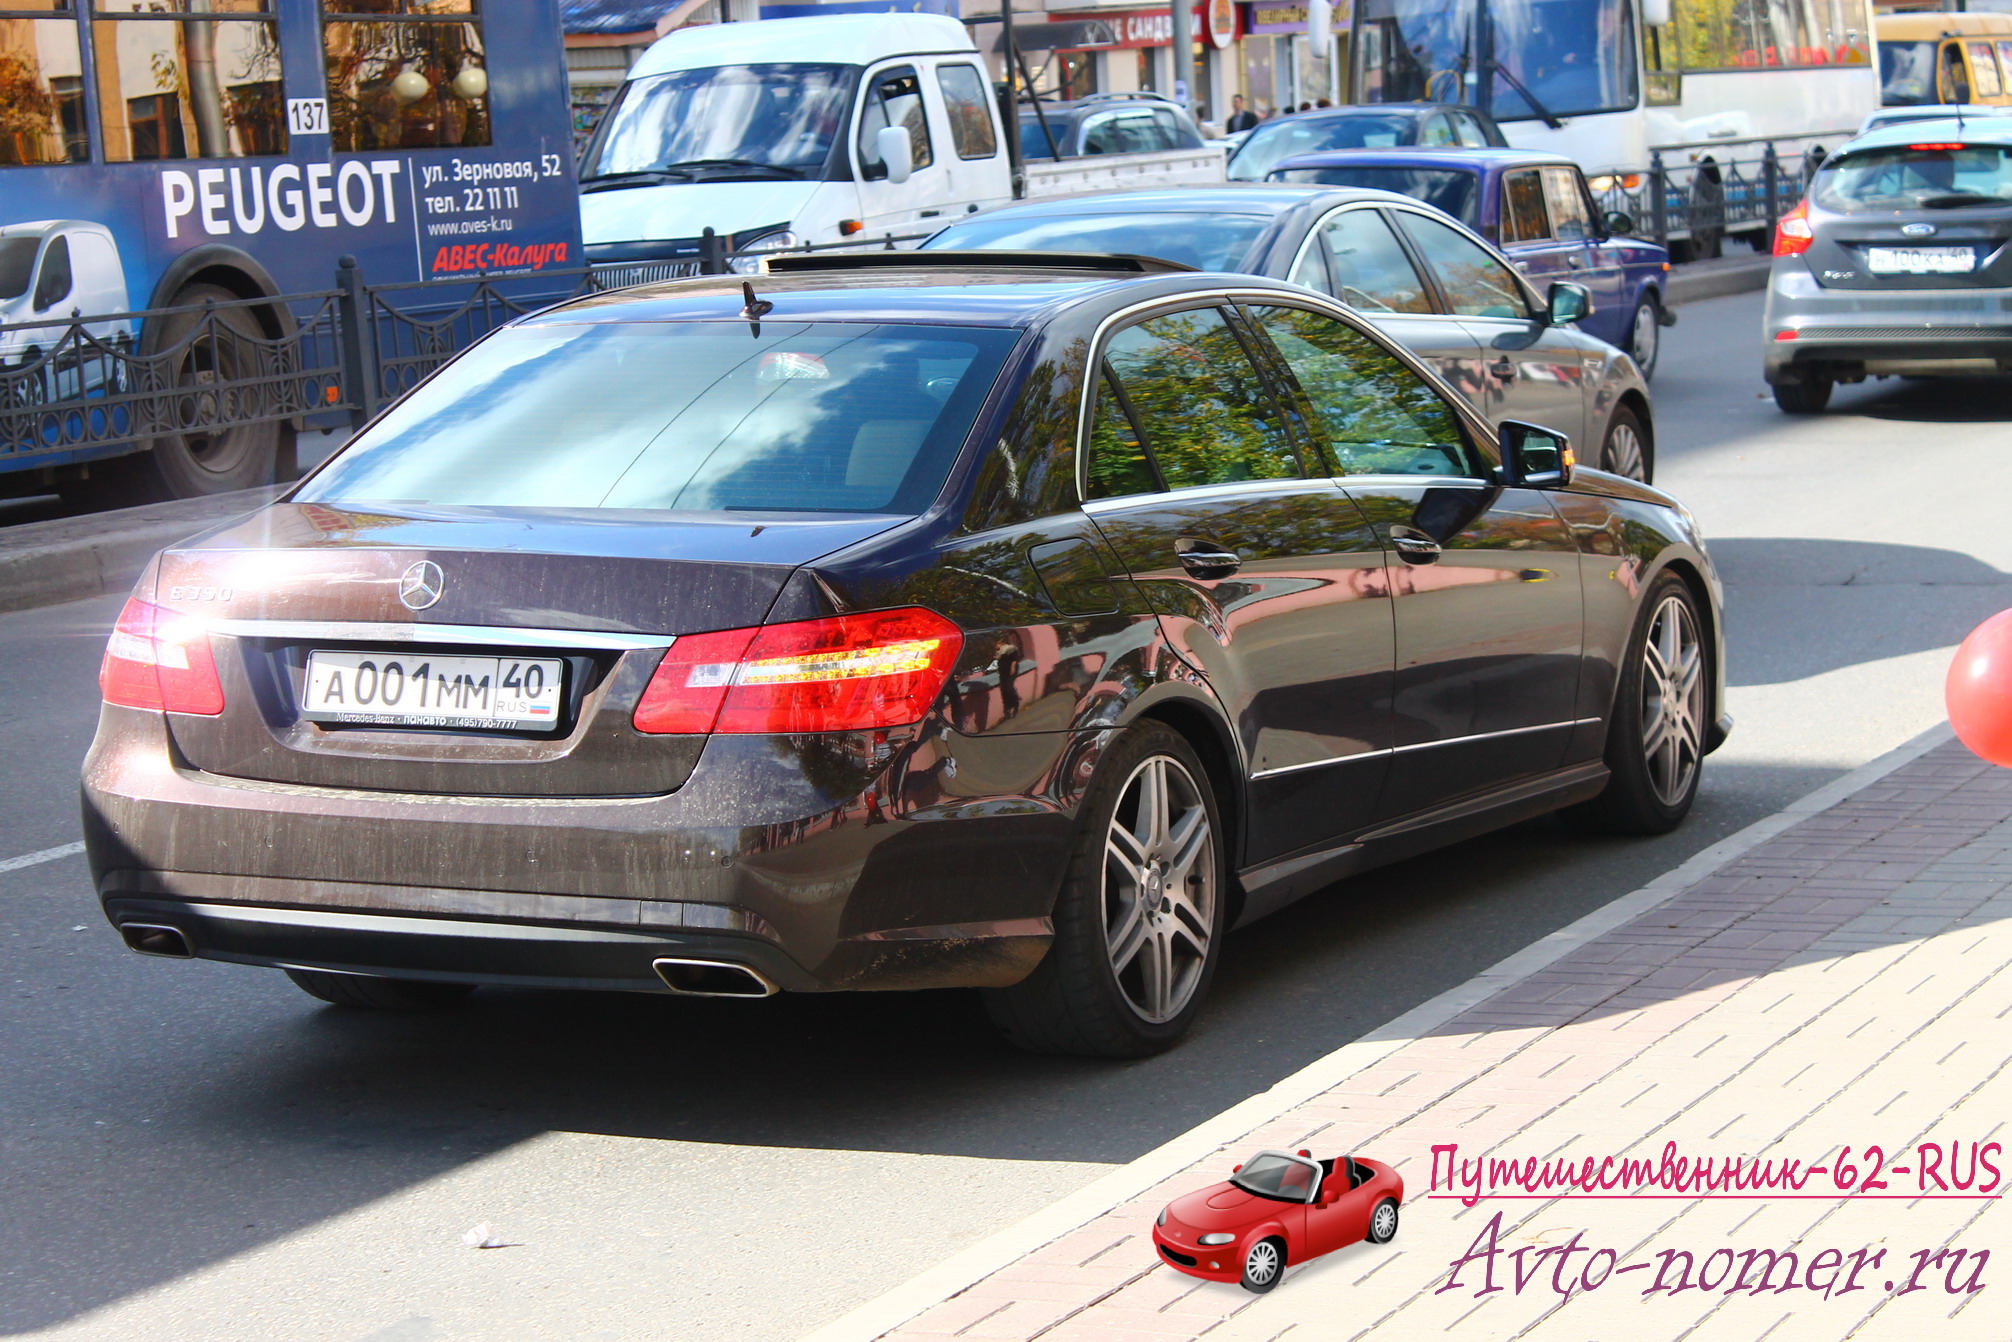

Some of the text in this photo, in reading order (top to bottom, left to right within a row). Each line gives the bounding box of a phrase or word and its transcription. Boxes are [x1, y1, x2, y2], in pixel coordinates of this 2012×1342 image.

[1127, 14, 1202, 43] САНДВИ
[291, 102, 324, 131] 137
[421, 154, 562, 189] ул. Зерновая, 52
[161, 160, 400, 238] PEUGEOT
[424, 186, 519, 214] тел. 22 11 11
[427, 215, 513, 236] www.aves-k.ru
[431, 242, 568, 272] АВЕС-Калуга
[502, 663, 544, 699] 40
[336, 711, 395, 724] Mercedes-Benz
[456, 717, 518, 730] (495)790-7777
[497, 700, 527, 713] RUS
